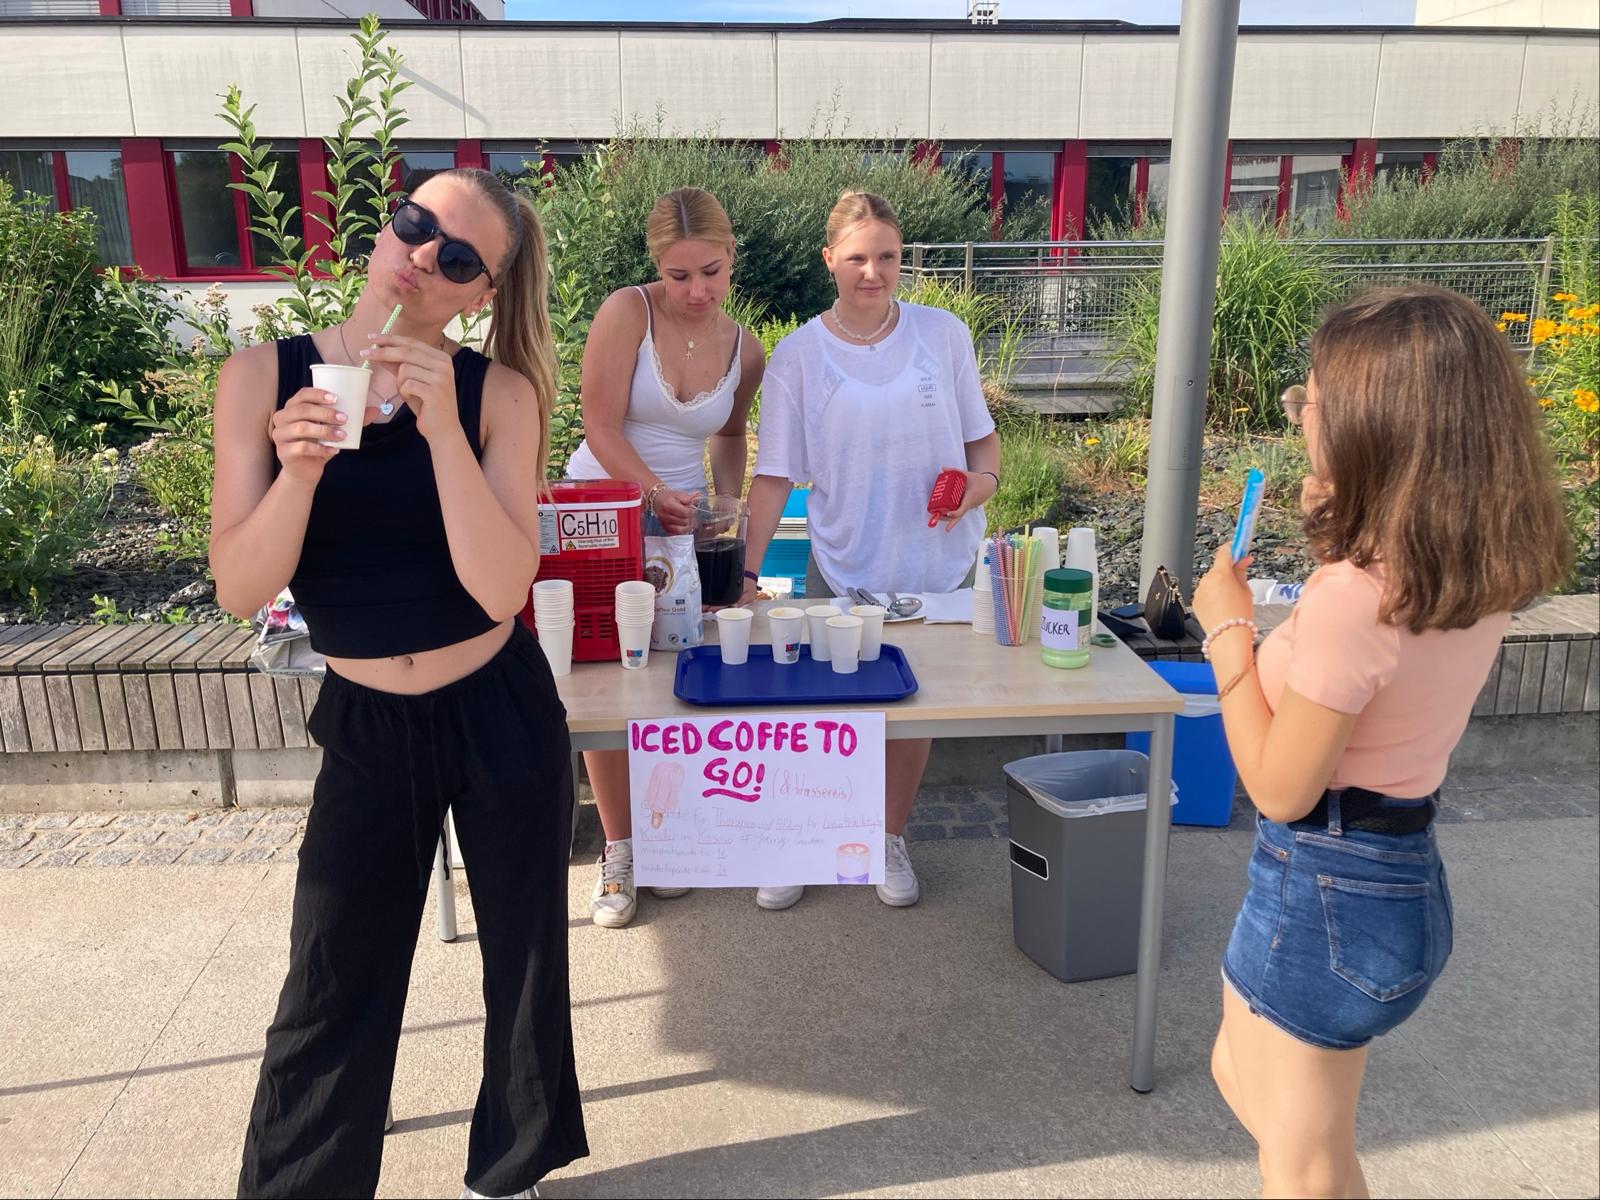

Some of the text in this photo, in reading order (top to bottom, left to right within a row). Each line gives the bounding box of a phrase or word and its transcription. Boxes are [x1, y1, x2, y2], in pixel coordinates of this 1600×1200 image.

[931, 475, 949, 502] JBL
[561, 512, 617, 537] C5H10
[1041, 615, 1075, 636] ZUCKER
[631, 719, 857, 757] ICED COFFE TO
[703, 757, 766, 793] GO!
